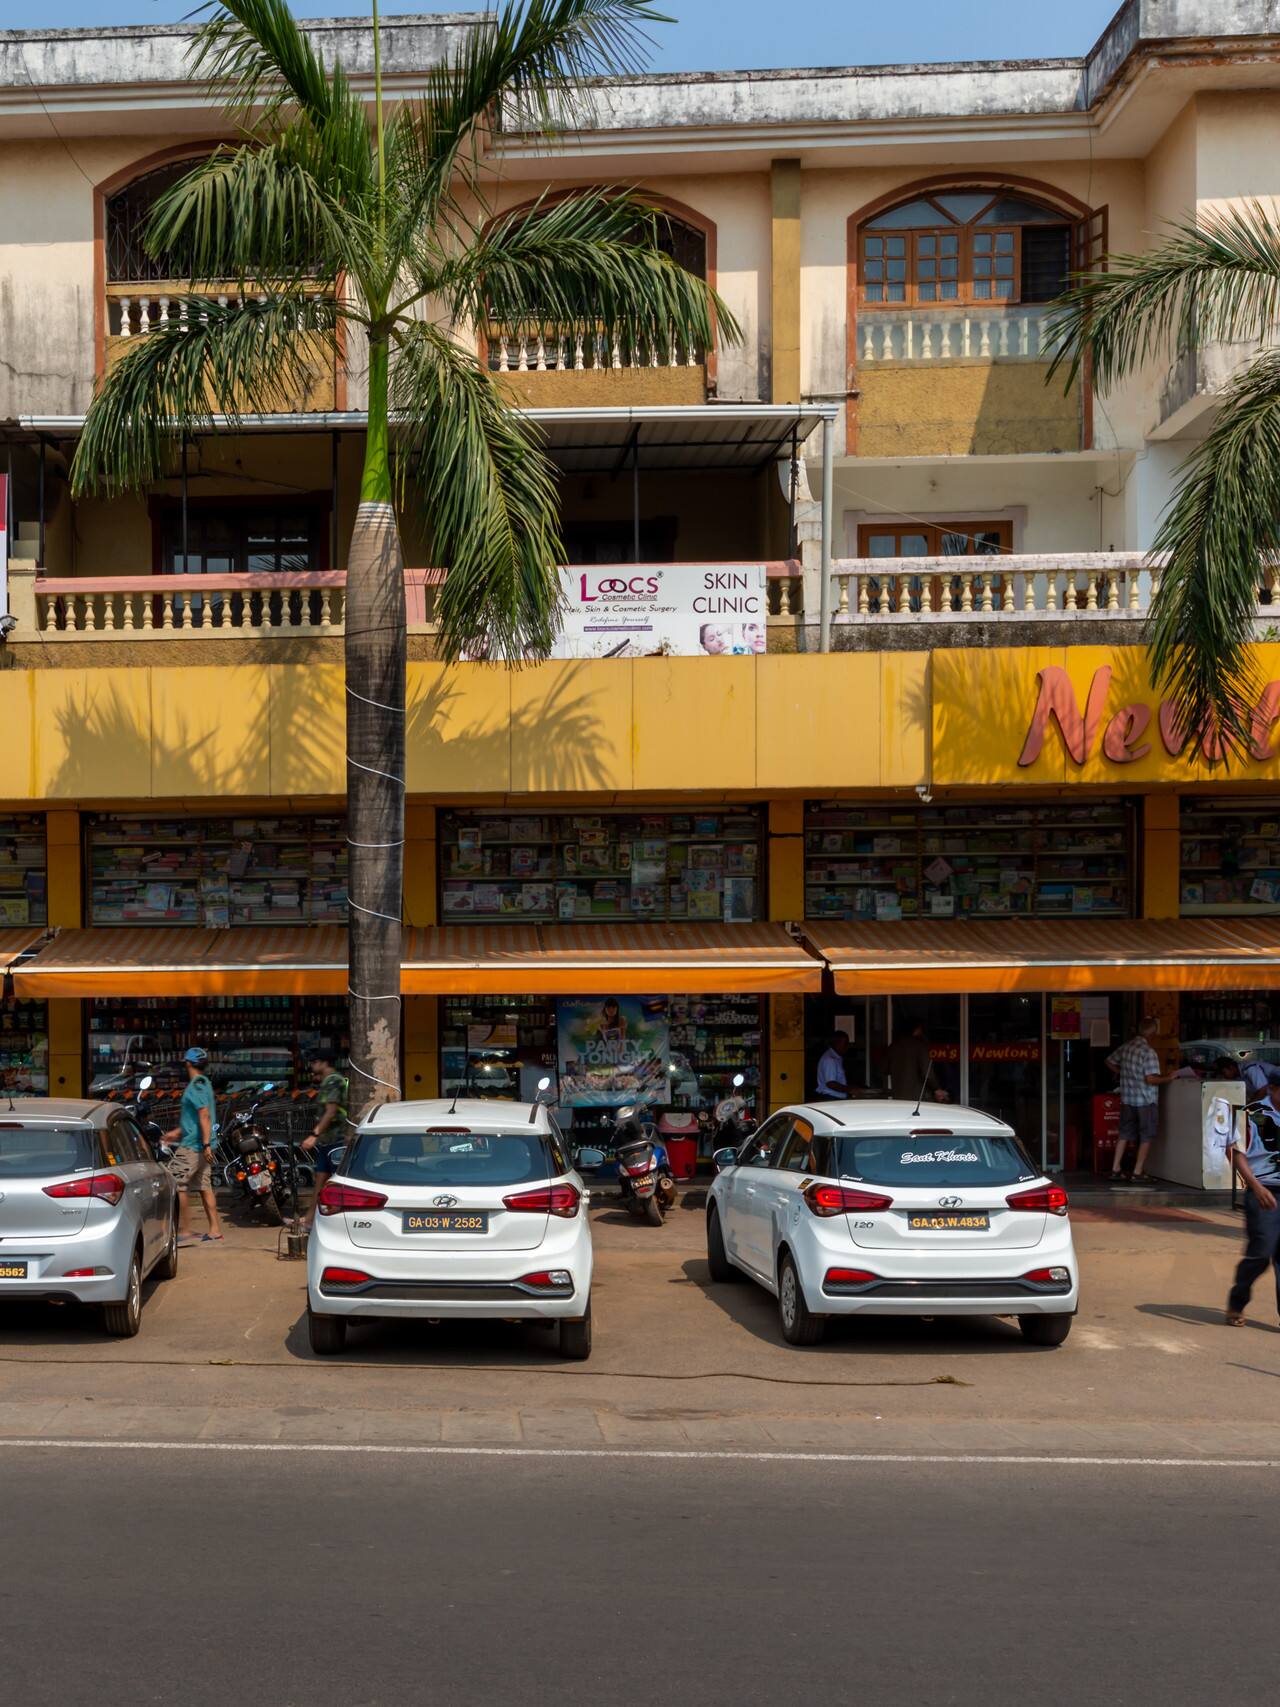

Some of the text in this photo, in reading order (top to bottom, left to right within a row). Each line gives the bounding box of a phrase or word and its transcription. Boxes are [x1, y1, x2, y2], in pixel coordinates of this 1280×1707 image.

[704, 573, 748, 590] SKIN
[602, 593, 657, 601] Cosmetic Clinic
[584, 605, 601, 613] Skin
[612, 604, 647, 612] Cosmetic
[649, 604, 677, 614] Surgery
[693, 597, 759, 613] CLINIC
[585, 1039, 644, 1052] PARTY
[973, 1043, 1039, 1060] Newton's
[912, 1216, 987, 1228] GA.03.W.4834
